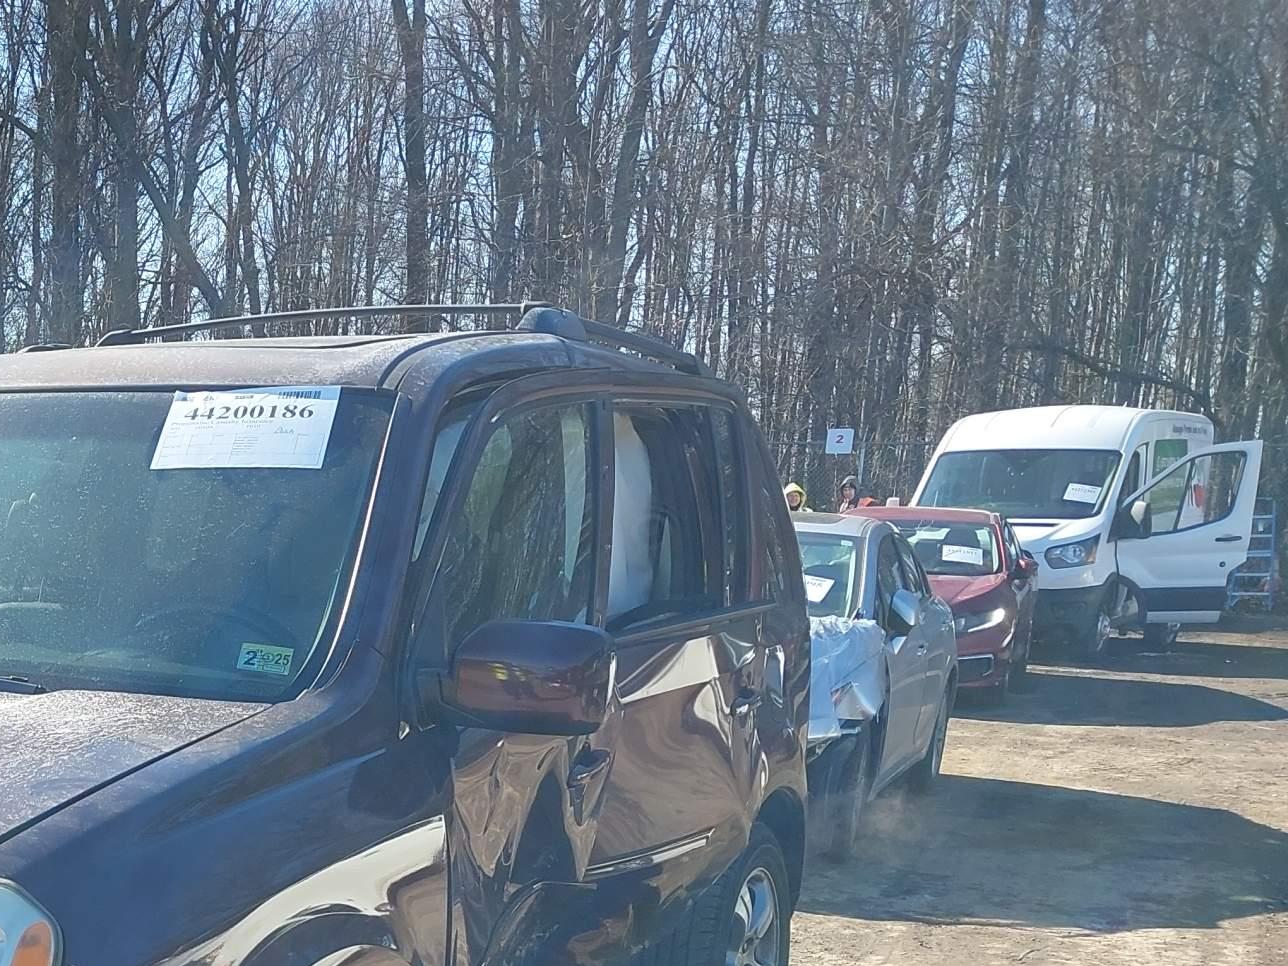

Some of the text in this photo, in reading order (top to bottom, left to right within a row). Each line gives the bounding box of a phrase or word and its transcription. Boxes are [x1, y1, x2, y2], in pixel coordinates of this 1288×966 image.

[184, 403, 314, 420] 44200186
[835, 434, 844, 444] 2
[243, 650, 258, 666] 2
[274, 653, 292, 666] 25
